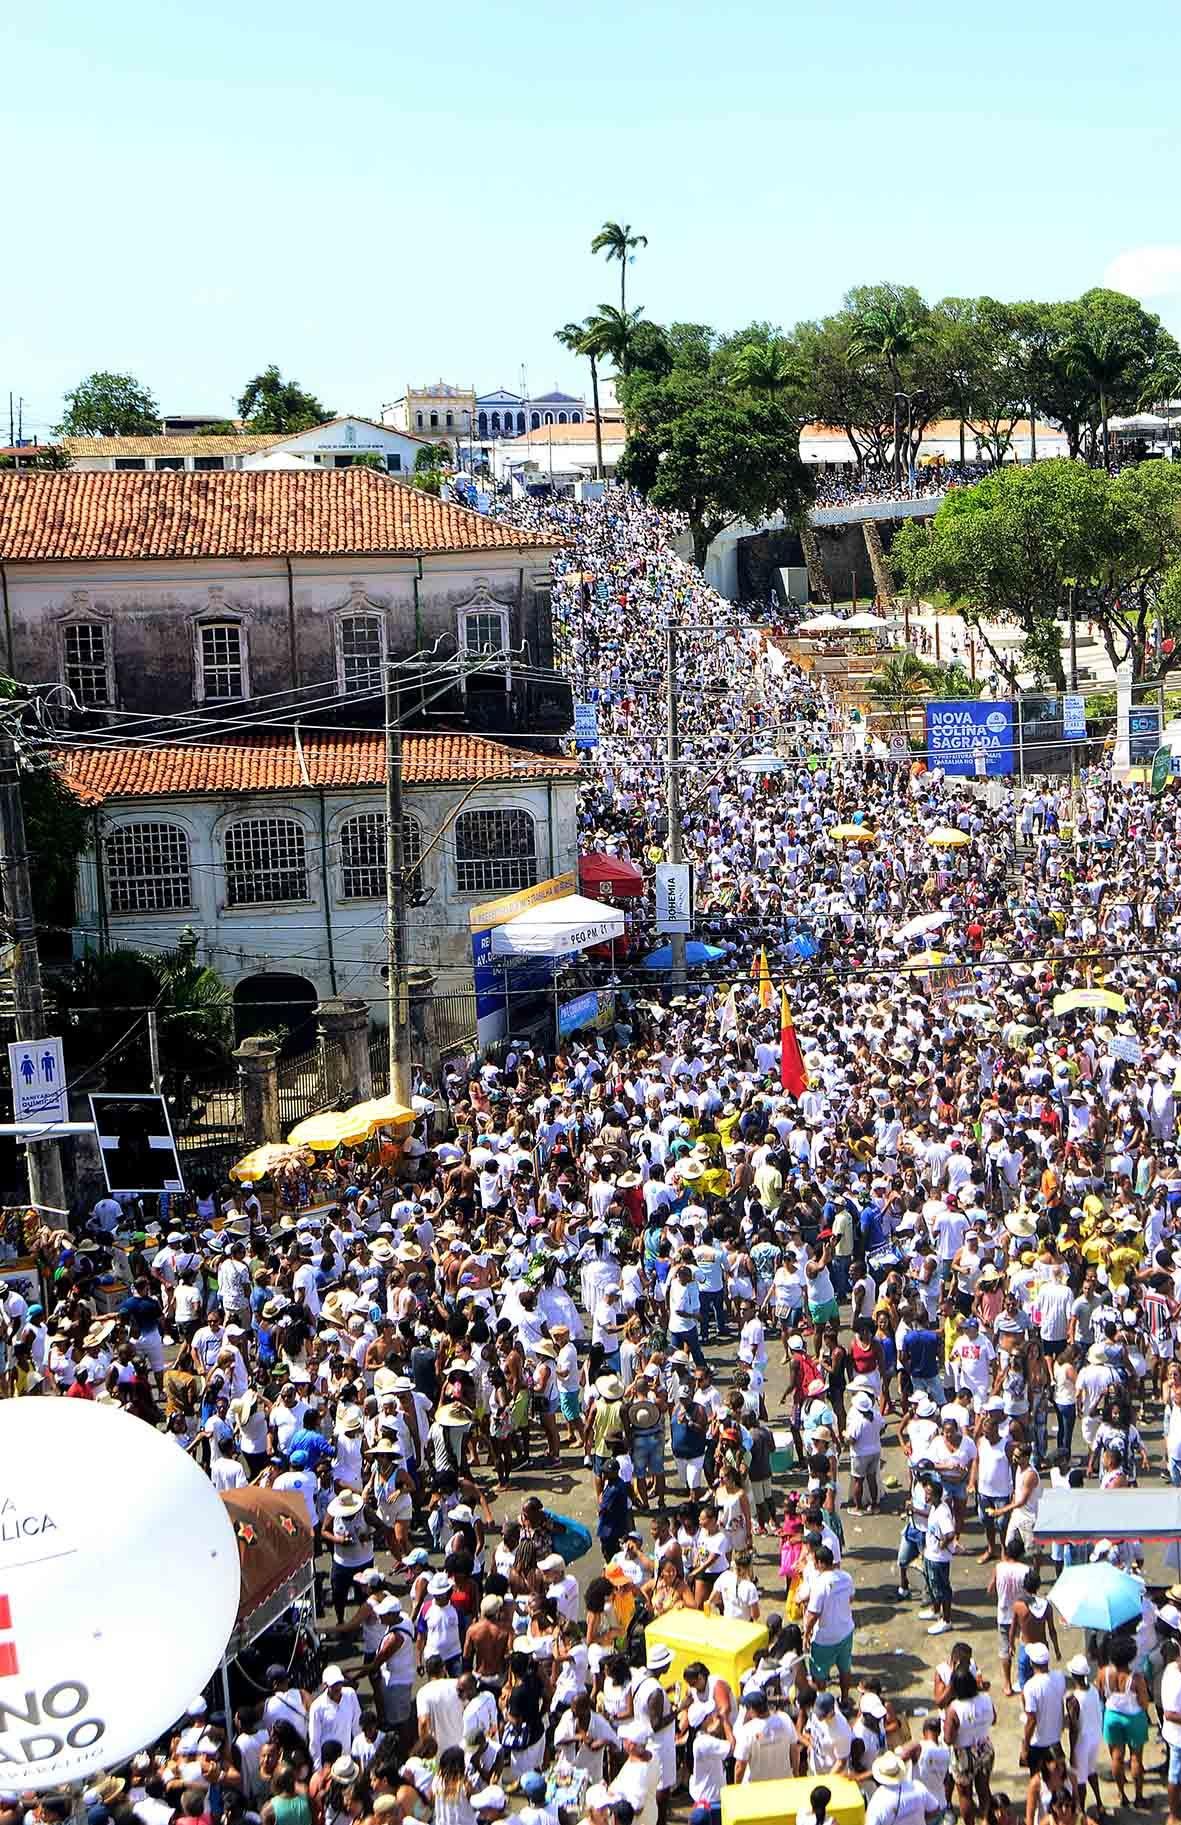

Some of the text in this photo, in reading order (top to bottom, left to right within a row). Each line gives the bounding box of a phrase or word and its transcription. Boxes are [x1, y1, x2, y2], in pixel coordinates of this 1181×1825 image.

[932, 712, 972, 724] NOVA
[932, 724, 987, 737] COLINA
[932, 736, 1000, 748] SAGRADA
[667, 877, 677, 921] BOHEMIA
